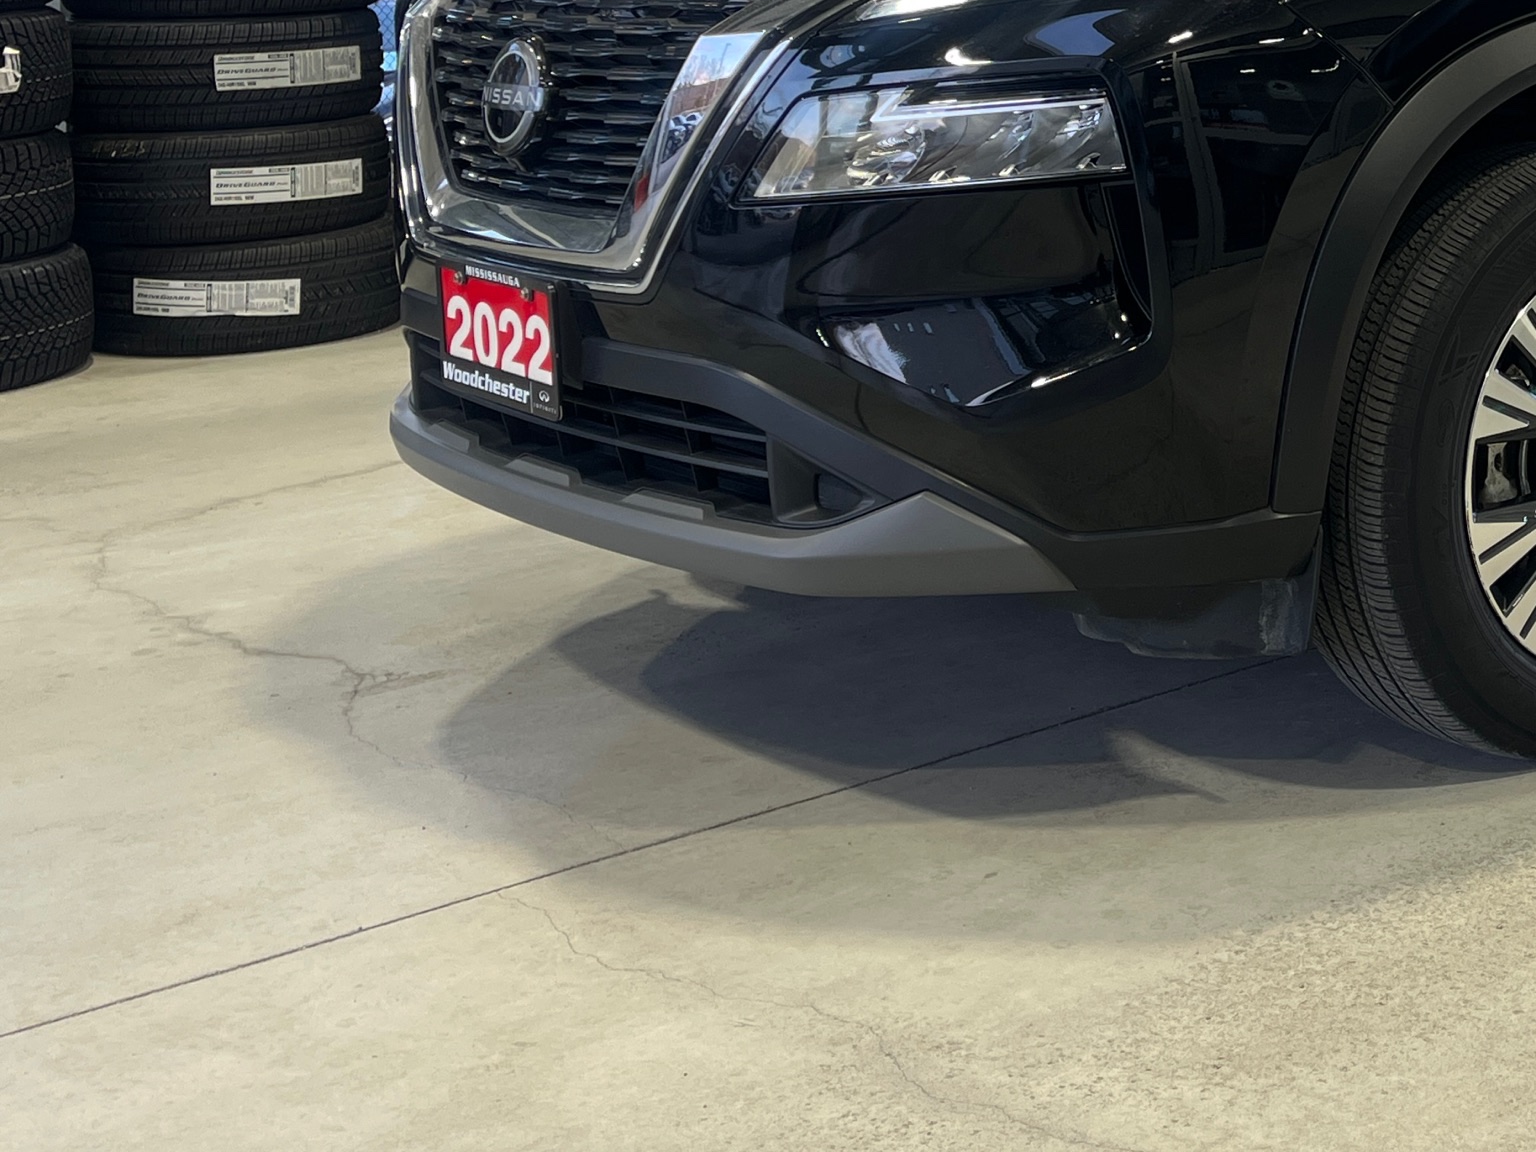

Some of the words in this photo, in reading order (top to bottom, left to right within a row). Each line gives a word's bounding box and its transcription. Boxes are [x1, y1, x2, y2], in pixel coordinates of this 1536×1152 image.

[481, 85, 542, 108] NISSAN
[464, 264, 521, 288] MISSISSAUGA
[446, 294, 554, 386] 2022
[442, 359, 531, 405] Woodchester
